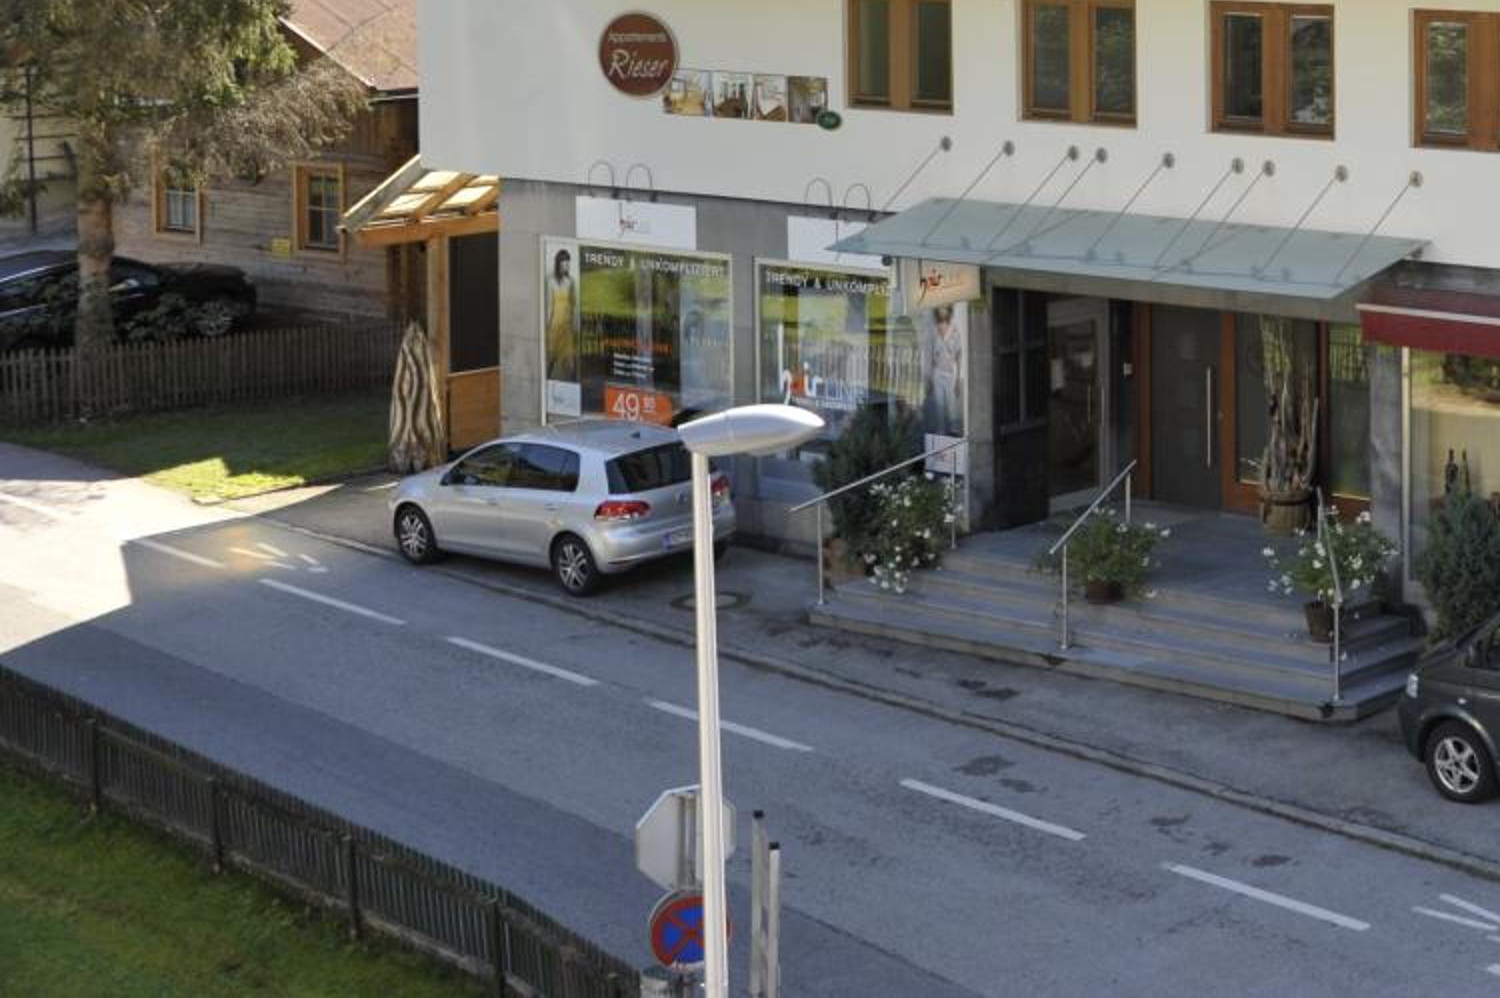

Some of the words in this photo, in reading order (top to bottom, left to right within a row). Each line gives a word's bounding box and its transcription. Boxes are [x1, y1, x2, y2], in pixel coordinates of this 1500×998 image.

[608, 49, 669, 79] Rieser
[585, 253, 624, 267] TRENDY
[766, 272, 808, 288] TRENDY
